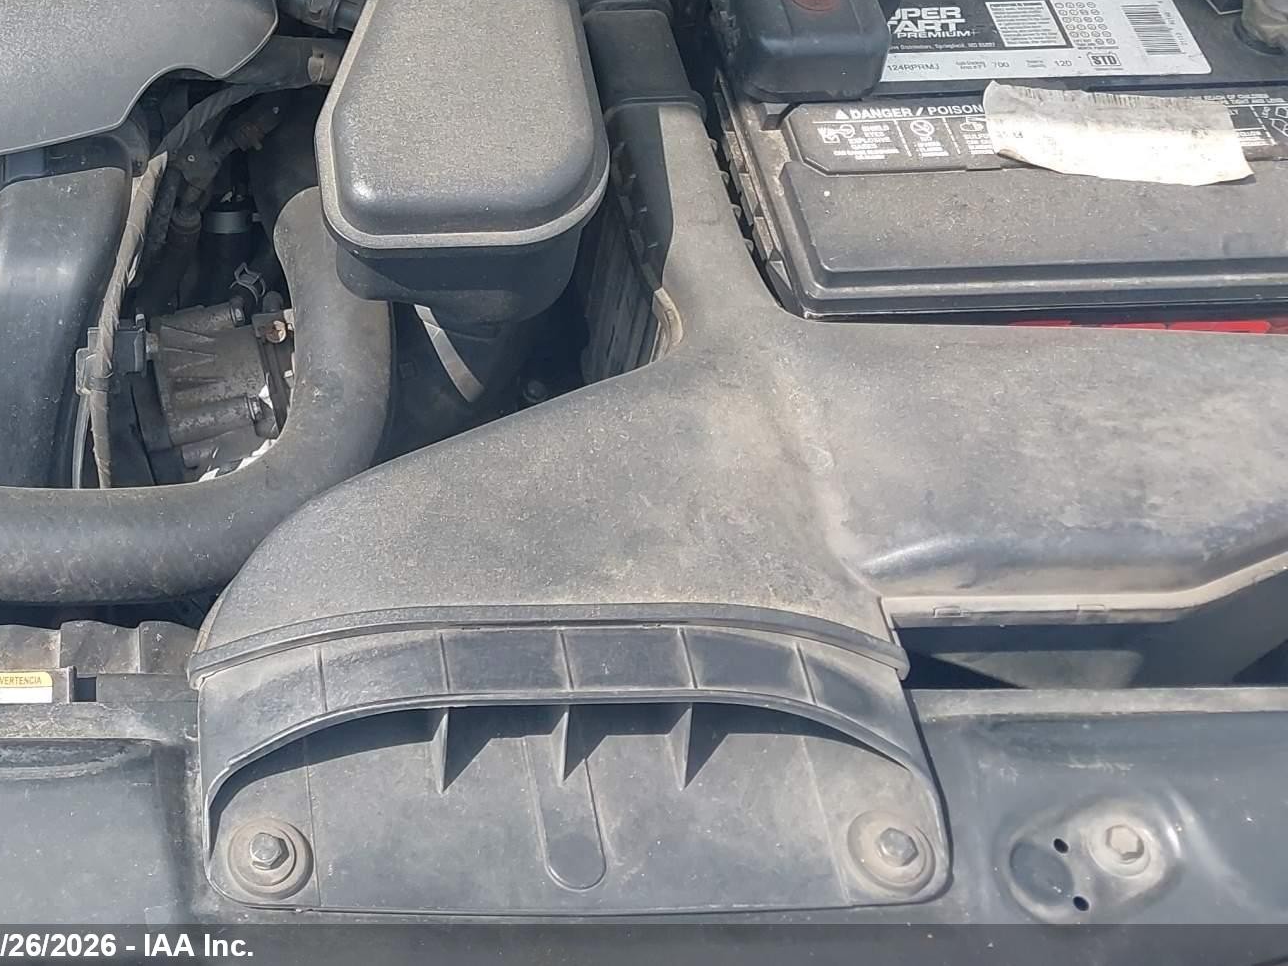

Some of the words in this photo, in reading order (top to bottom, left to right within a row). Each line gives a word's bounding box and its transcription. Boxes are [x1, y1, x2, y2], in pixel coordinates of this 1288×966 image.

[1054, 59, 1072, 67] 120
[1091, 55, 1117, 65] STD
[849, 107, 913, 120] DANGER
[927, 104, 984, 116] POISON
